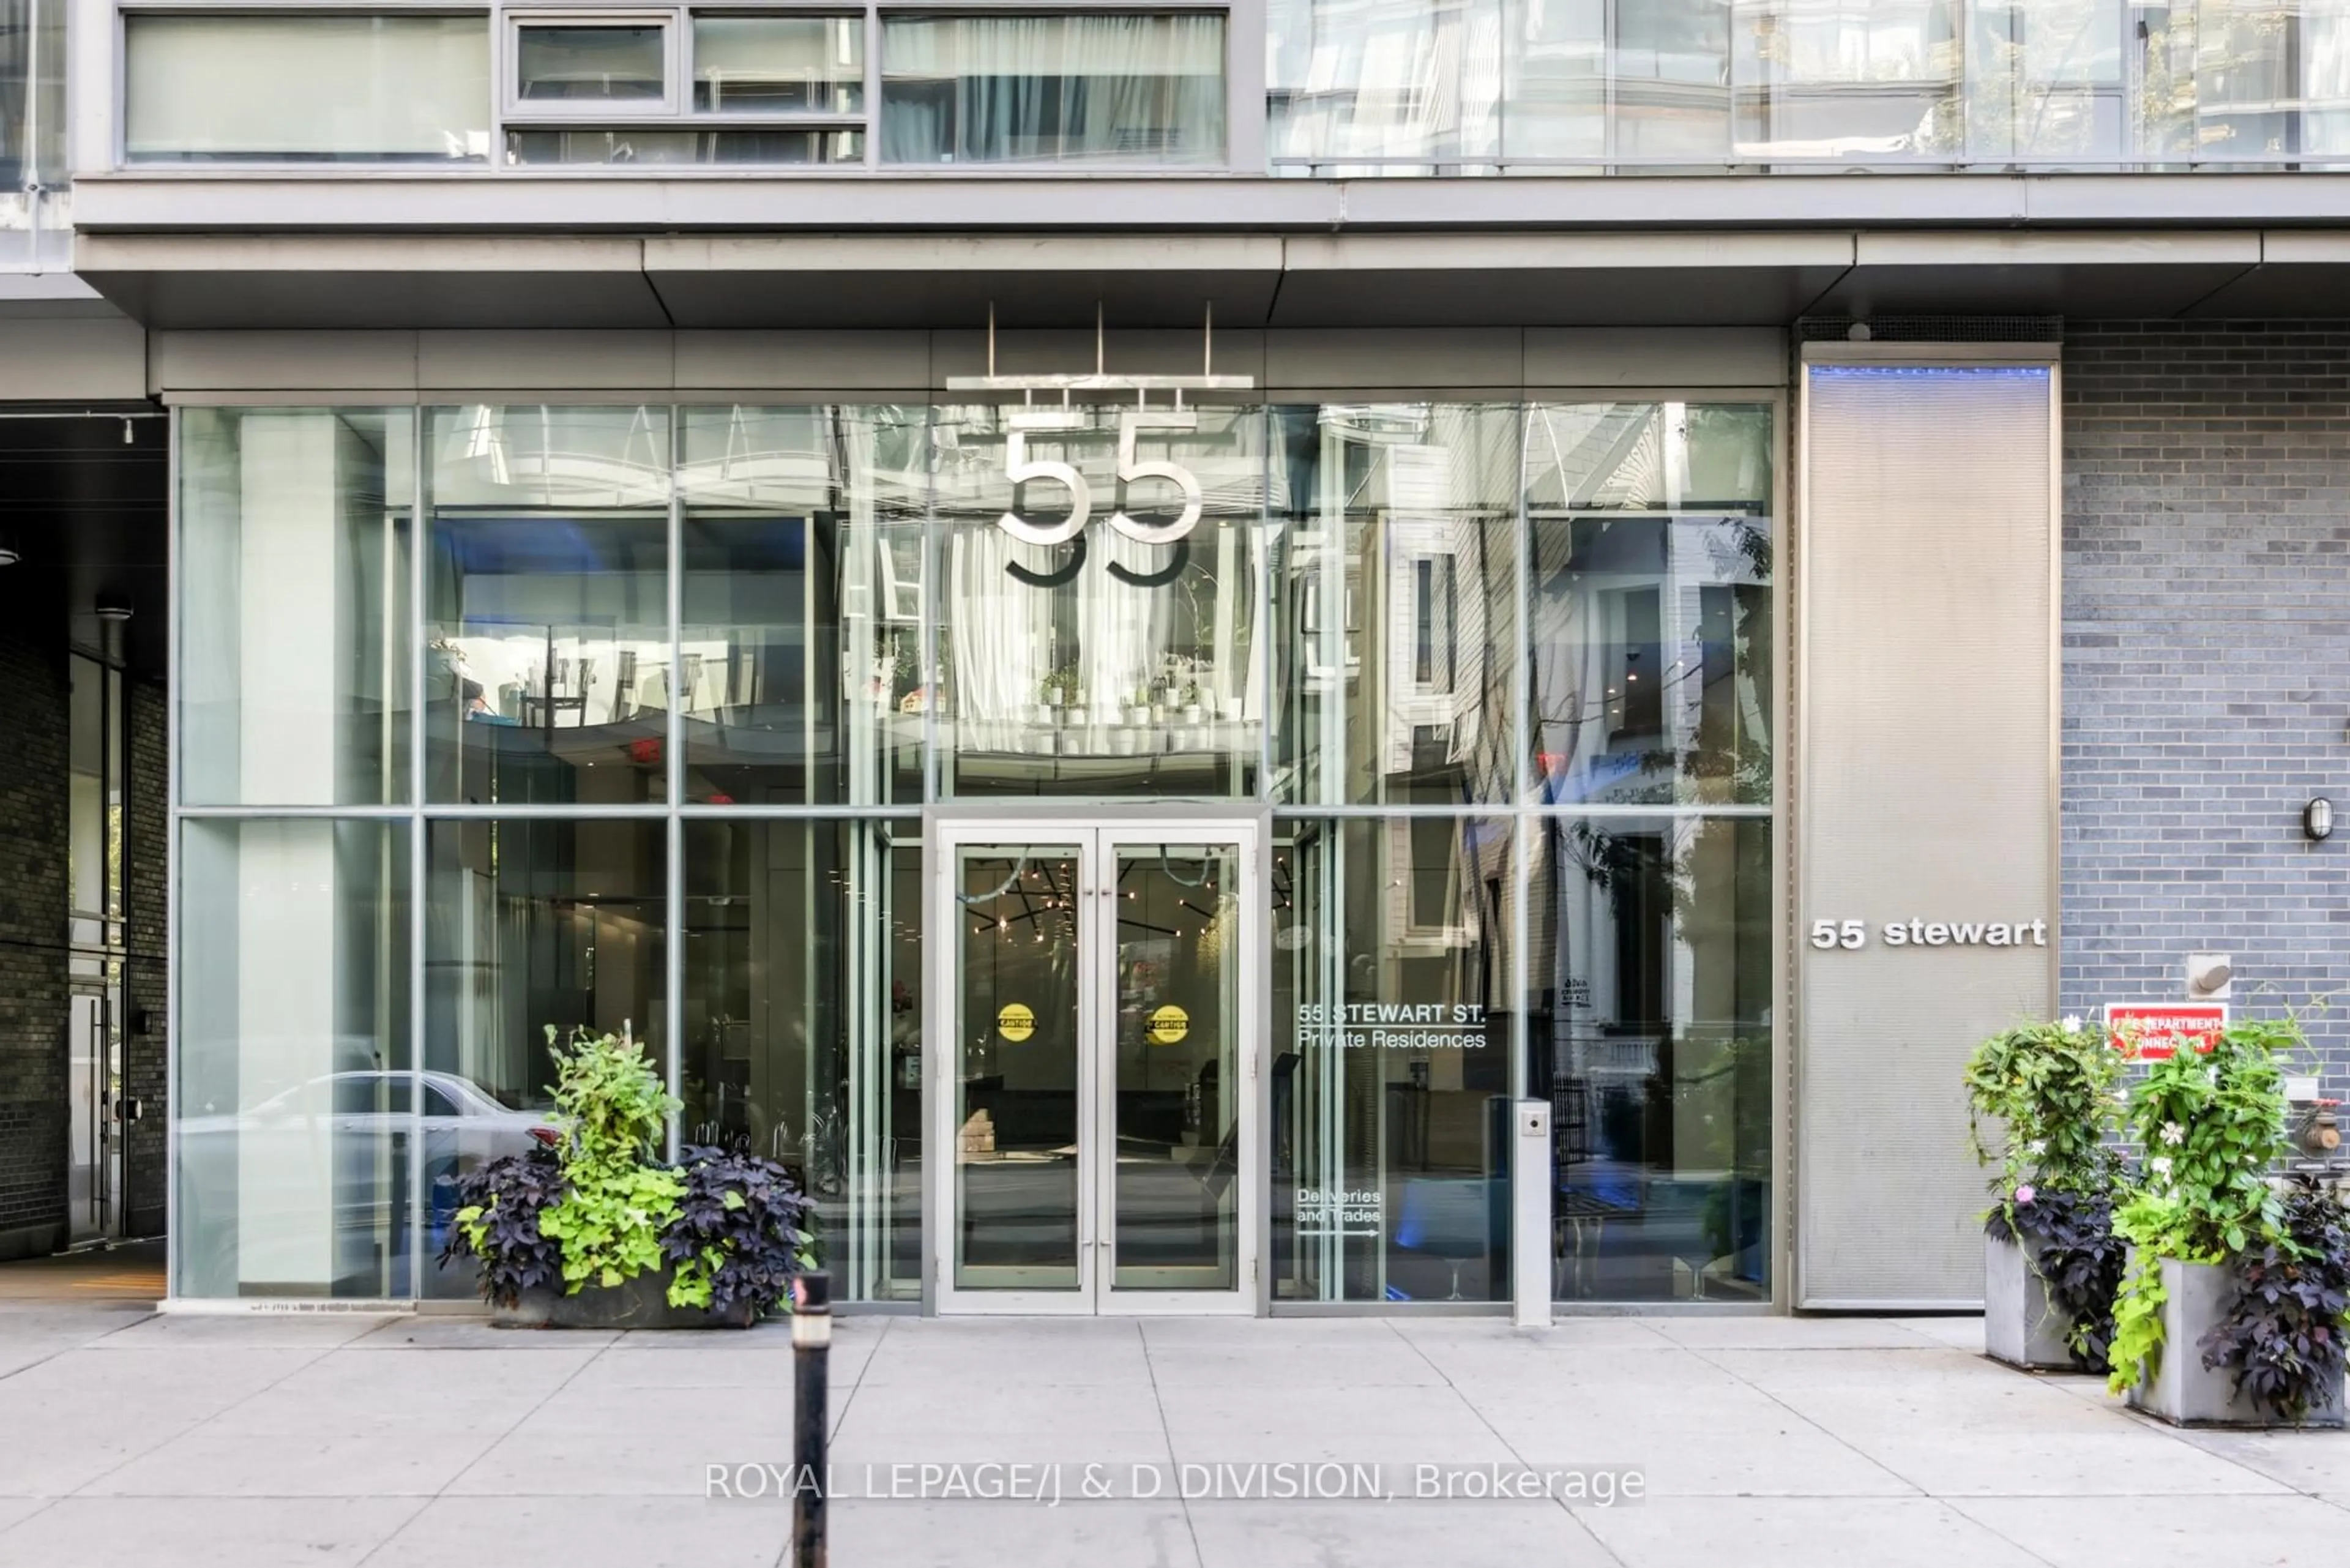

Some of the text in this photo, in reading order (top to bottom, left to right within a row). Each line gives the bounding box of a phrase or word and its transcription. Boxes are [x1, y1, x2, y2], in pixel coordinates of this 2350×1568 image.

[998, 413, 1203, 545] 55
[1811, 917, 2046, 949] 55 stewart
[1299, 1004, 1486, 1023] 55 STEWART ST.
[1298, 1029, 1486, 1048] Private Residences
[1297, 1209, 1326, 1222] and
